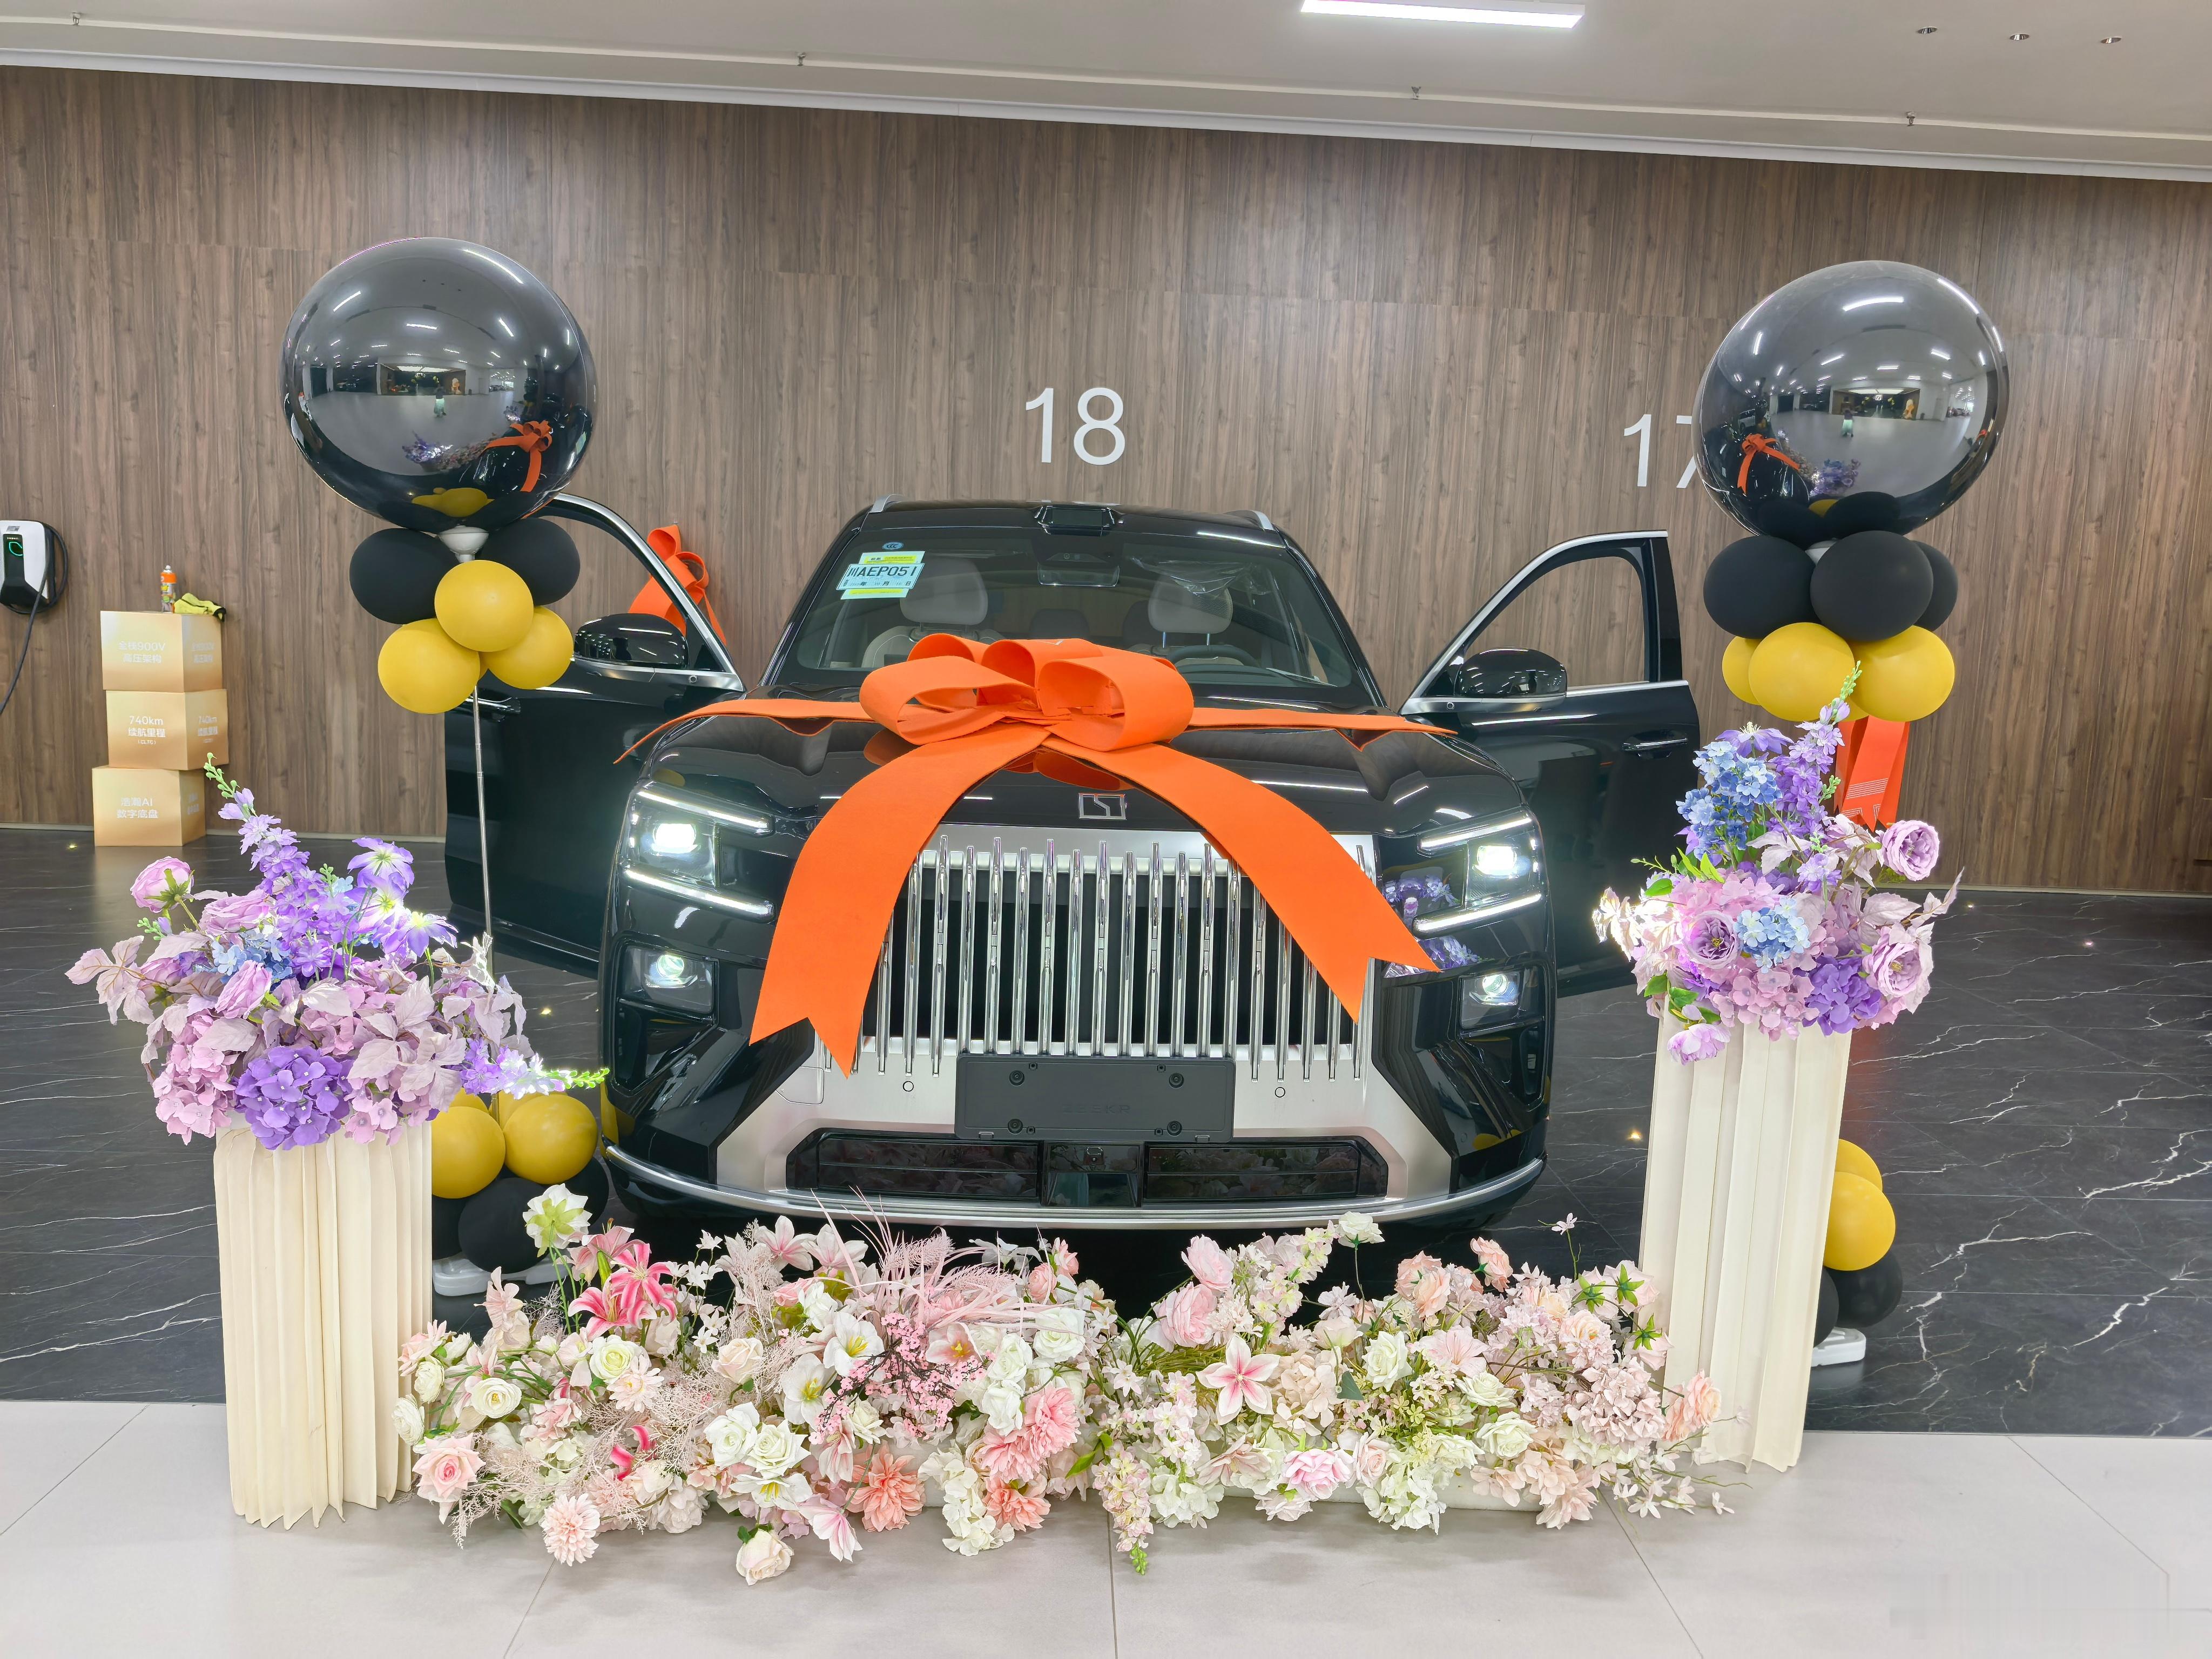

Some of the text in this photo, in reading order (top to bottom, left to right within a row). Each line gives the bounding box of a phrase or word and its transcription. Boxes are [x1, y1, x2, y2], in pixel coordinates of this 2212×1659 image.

[1026, 387, 1125, 466] 18
[847, 566, 918, 577] 川AEP051
[129, 716, 164, 725] 740km
[117, 809, 159, 819] 数字底盘
